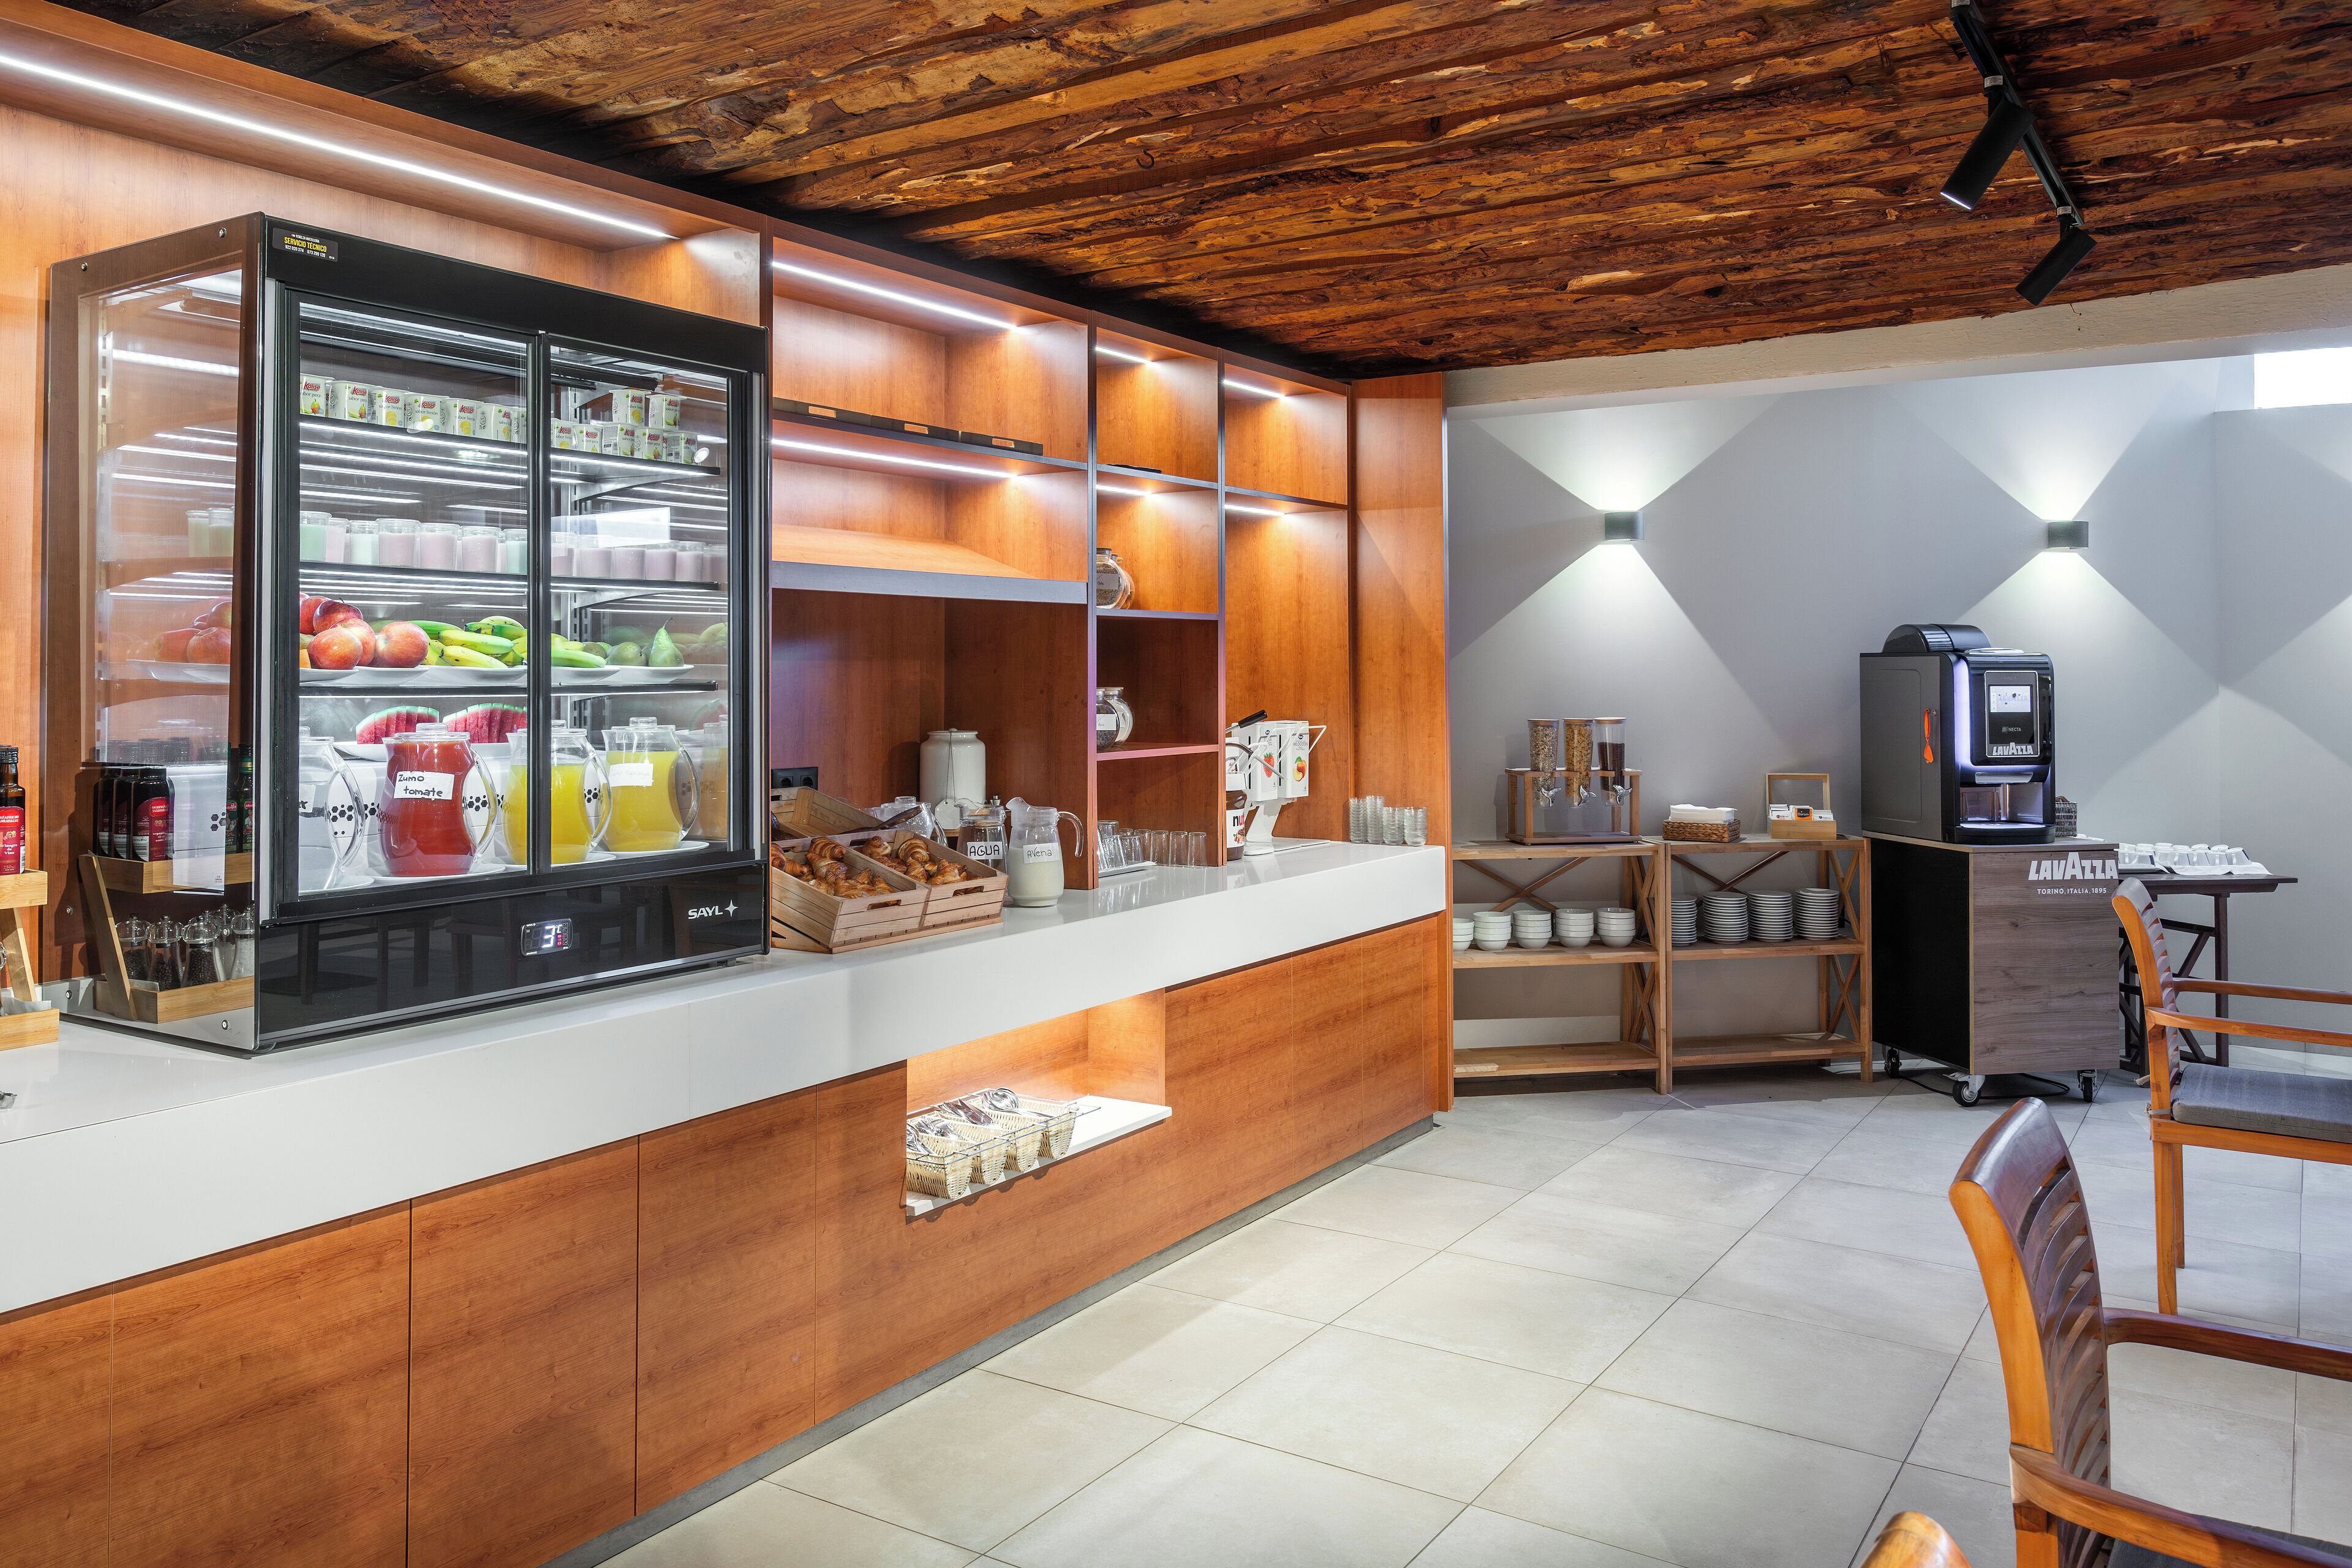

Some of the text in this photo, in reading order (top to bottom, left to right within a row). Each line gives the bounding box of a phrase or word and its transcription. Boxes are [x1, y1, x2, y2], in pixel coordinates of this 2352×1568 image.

[284, 237, 326, 252] SERVICIO TÉCNICO
[304, 382, 321, 391] Kalise
[352, 386, 368, 396] Kalise
[385, 395, 401, 404] Kalise
[460, 405, 475, 414] Kalise
[1992, 742, 2034, 755] LAVAZZA
[404, 786, 443, 797] tomate
[970, 845, 1000, 856] AGUA
[2029, 852, 2119, 880] LAVAZZA
[688, 905, 723, 919] SAYL
